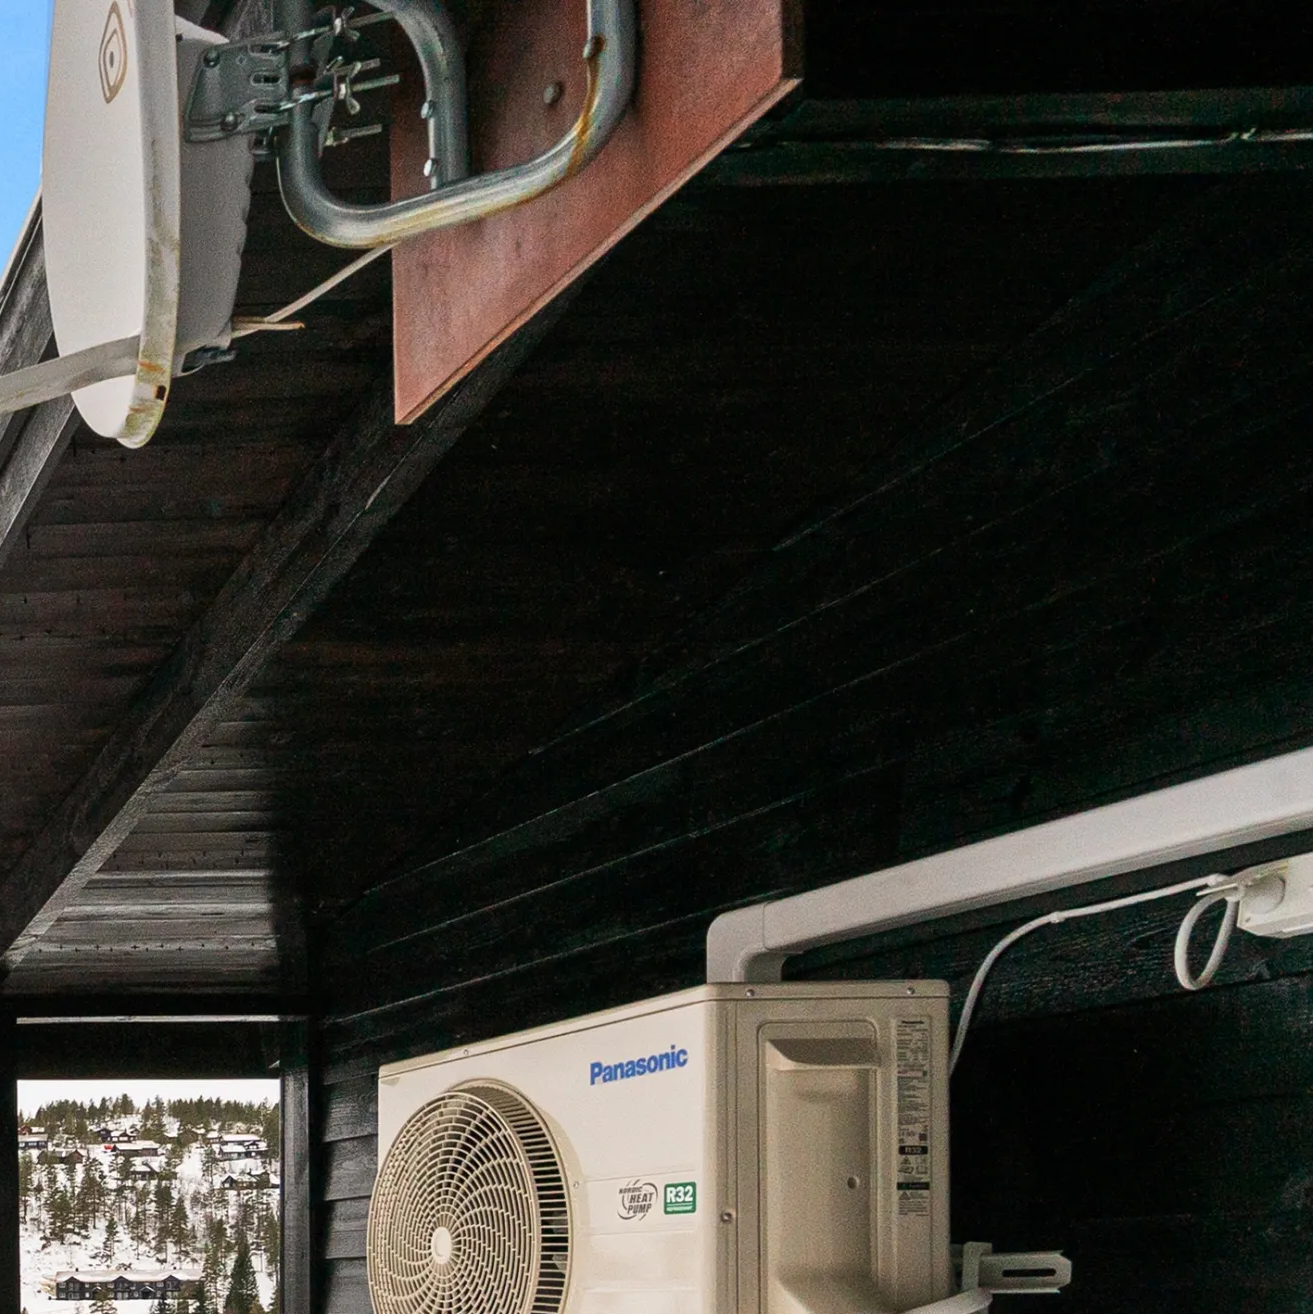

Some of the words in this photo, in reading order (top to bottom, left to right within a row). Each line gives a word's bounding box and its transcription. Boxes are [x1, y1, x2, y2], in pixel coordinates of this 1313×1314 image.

[590, 1044, 688, 1086] Panasonic
[618, 1186, 643, 1195] NORDIC
[666, 1185, 693, 1203] R32
[629, 1192, 654, 1204] HEAT
[627, 1203, 652, 1214] PUMP
